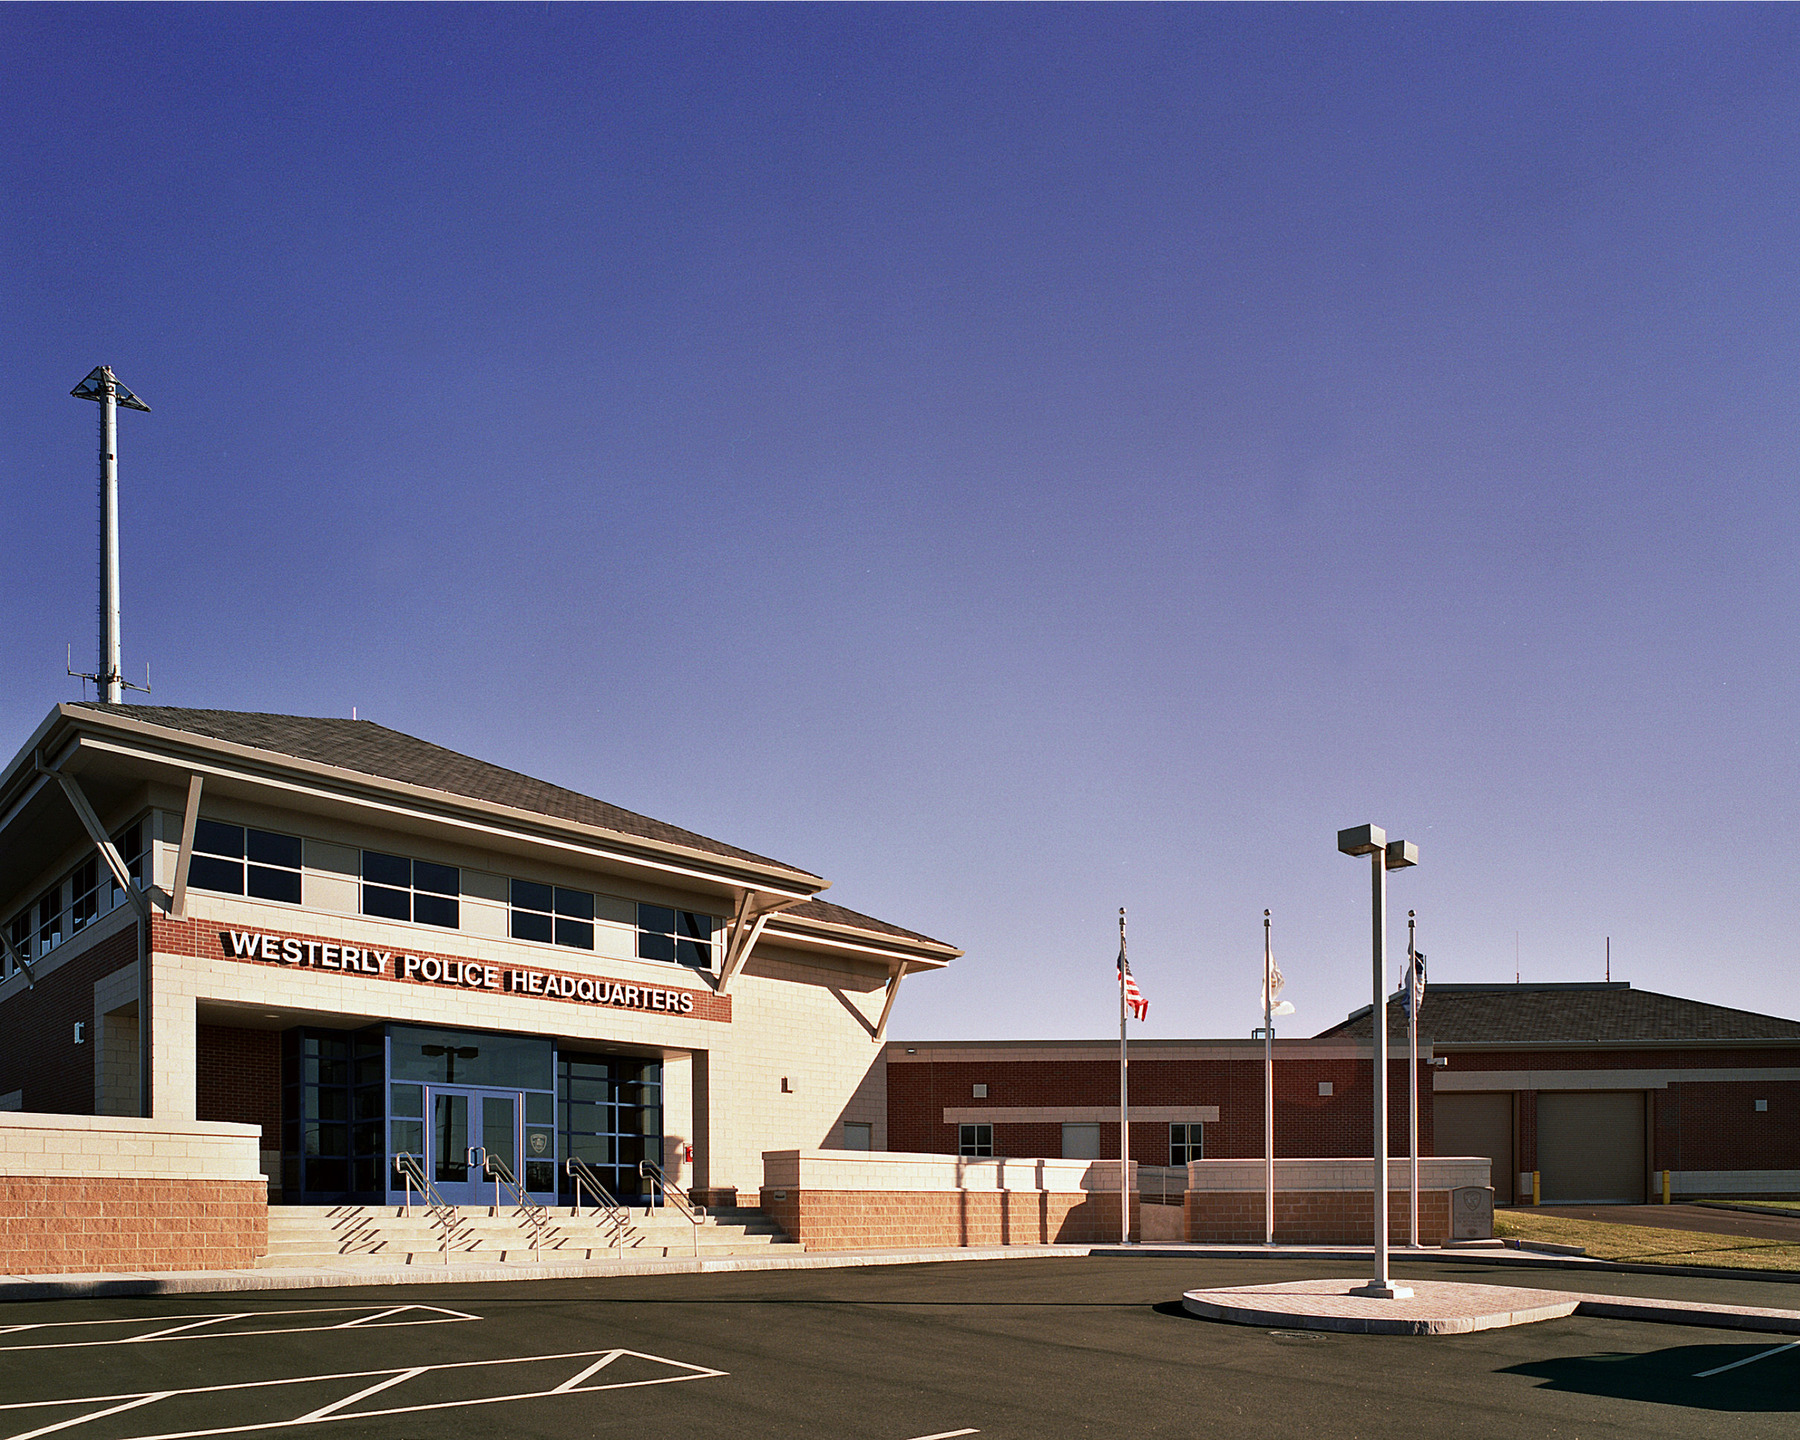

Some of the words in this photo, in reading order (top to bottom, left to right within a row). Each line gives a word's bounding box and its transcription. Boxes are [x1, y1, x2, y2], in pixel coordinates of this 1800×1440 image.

[229, 930, 391, 974] WESTERLY
[403, 955, 499, 989] POLICE
[510, 970, 694, 1013] HEADQUARTERS
